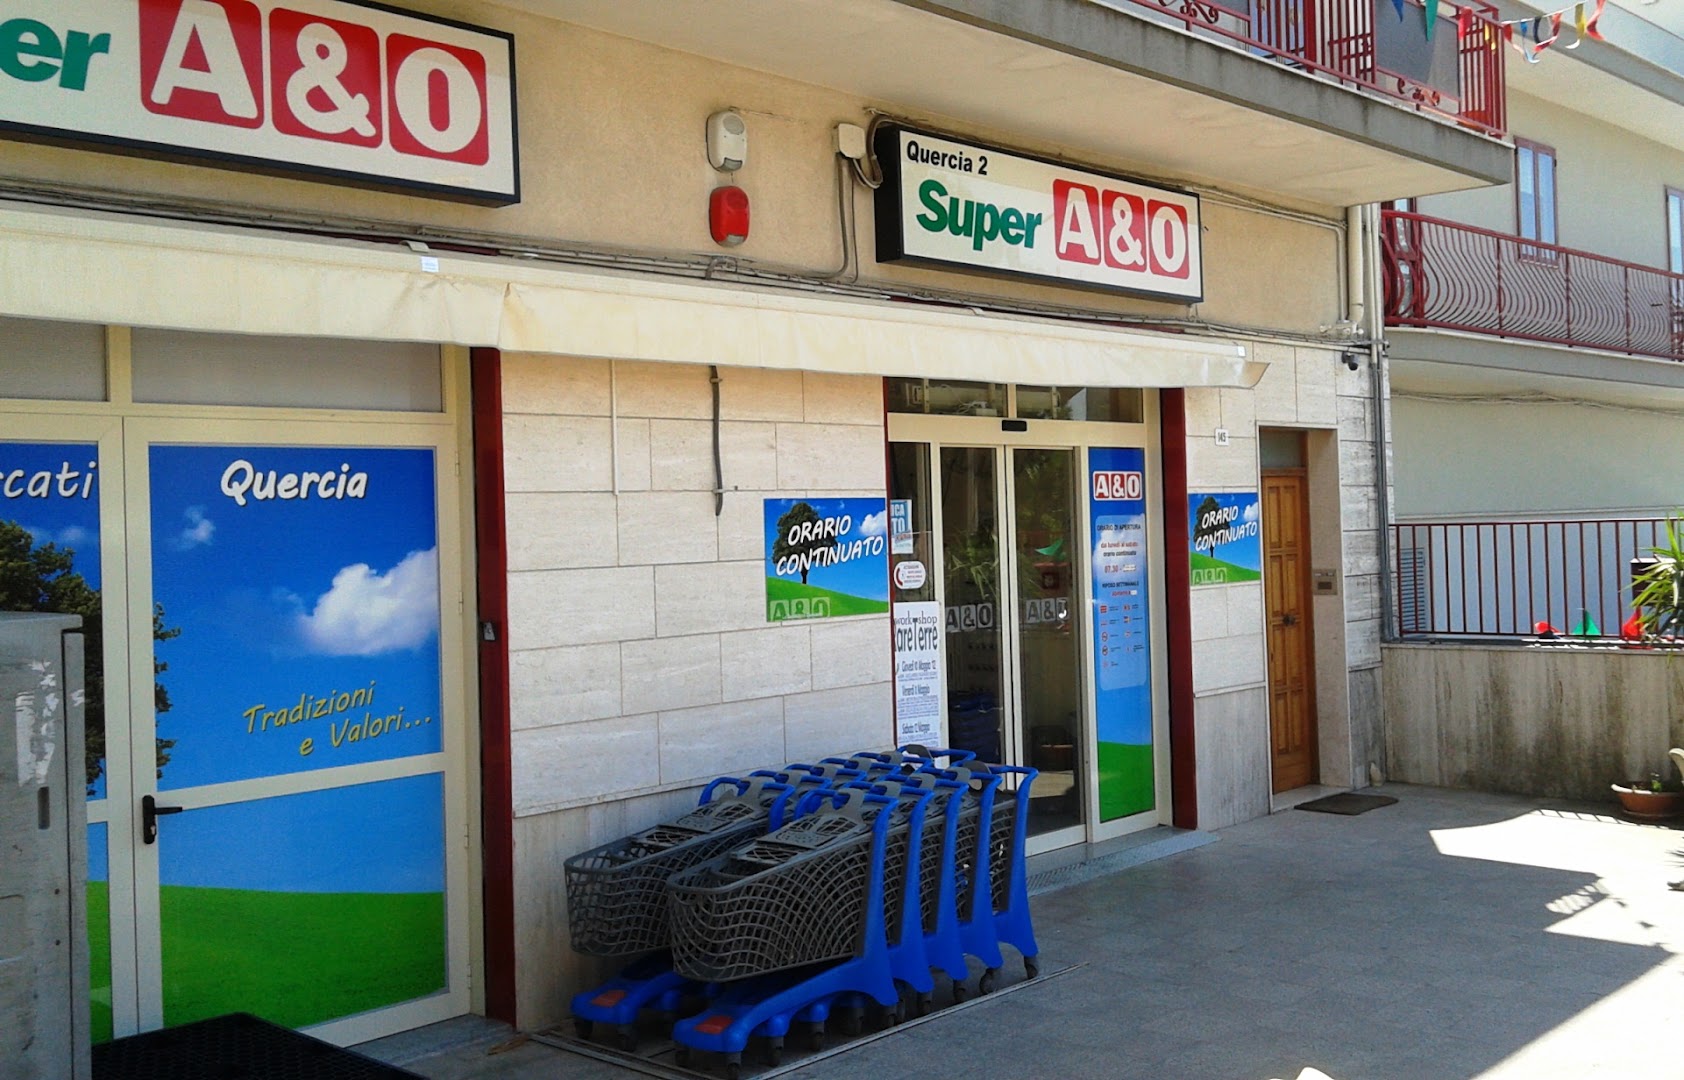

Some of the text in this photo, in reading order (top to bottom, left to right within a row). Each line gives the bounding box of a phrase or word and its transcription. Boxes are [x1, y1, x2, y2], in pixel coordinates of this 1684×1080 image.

[907, 140, 988, 176] Quercia 2
[916, 179, 1187, 273] Super A&O
[0, 461, 97, 499] cati
[220, 459, 368, 506] Quercia
[1095, 475, 1140, 497] A&O
[788, 515, 852, 546] ORARIO
[1195, 521, 1258, 551] CONTINUATO
[1201, 505, 1239, 529] ORARIO
[776, 535, 884, 576] CONTINUATO
[243, 681, 376, 733] Tradizioni
[300, 709, 432, 755] e Valori...
